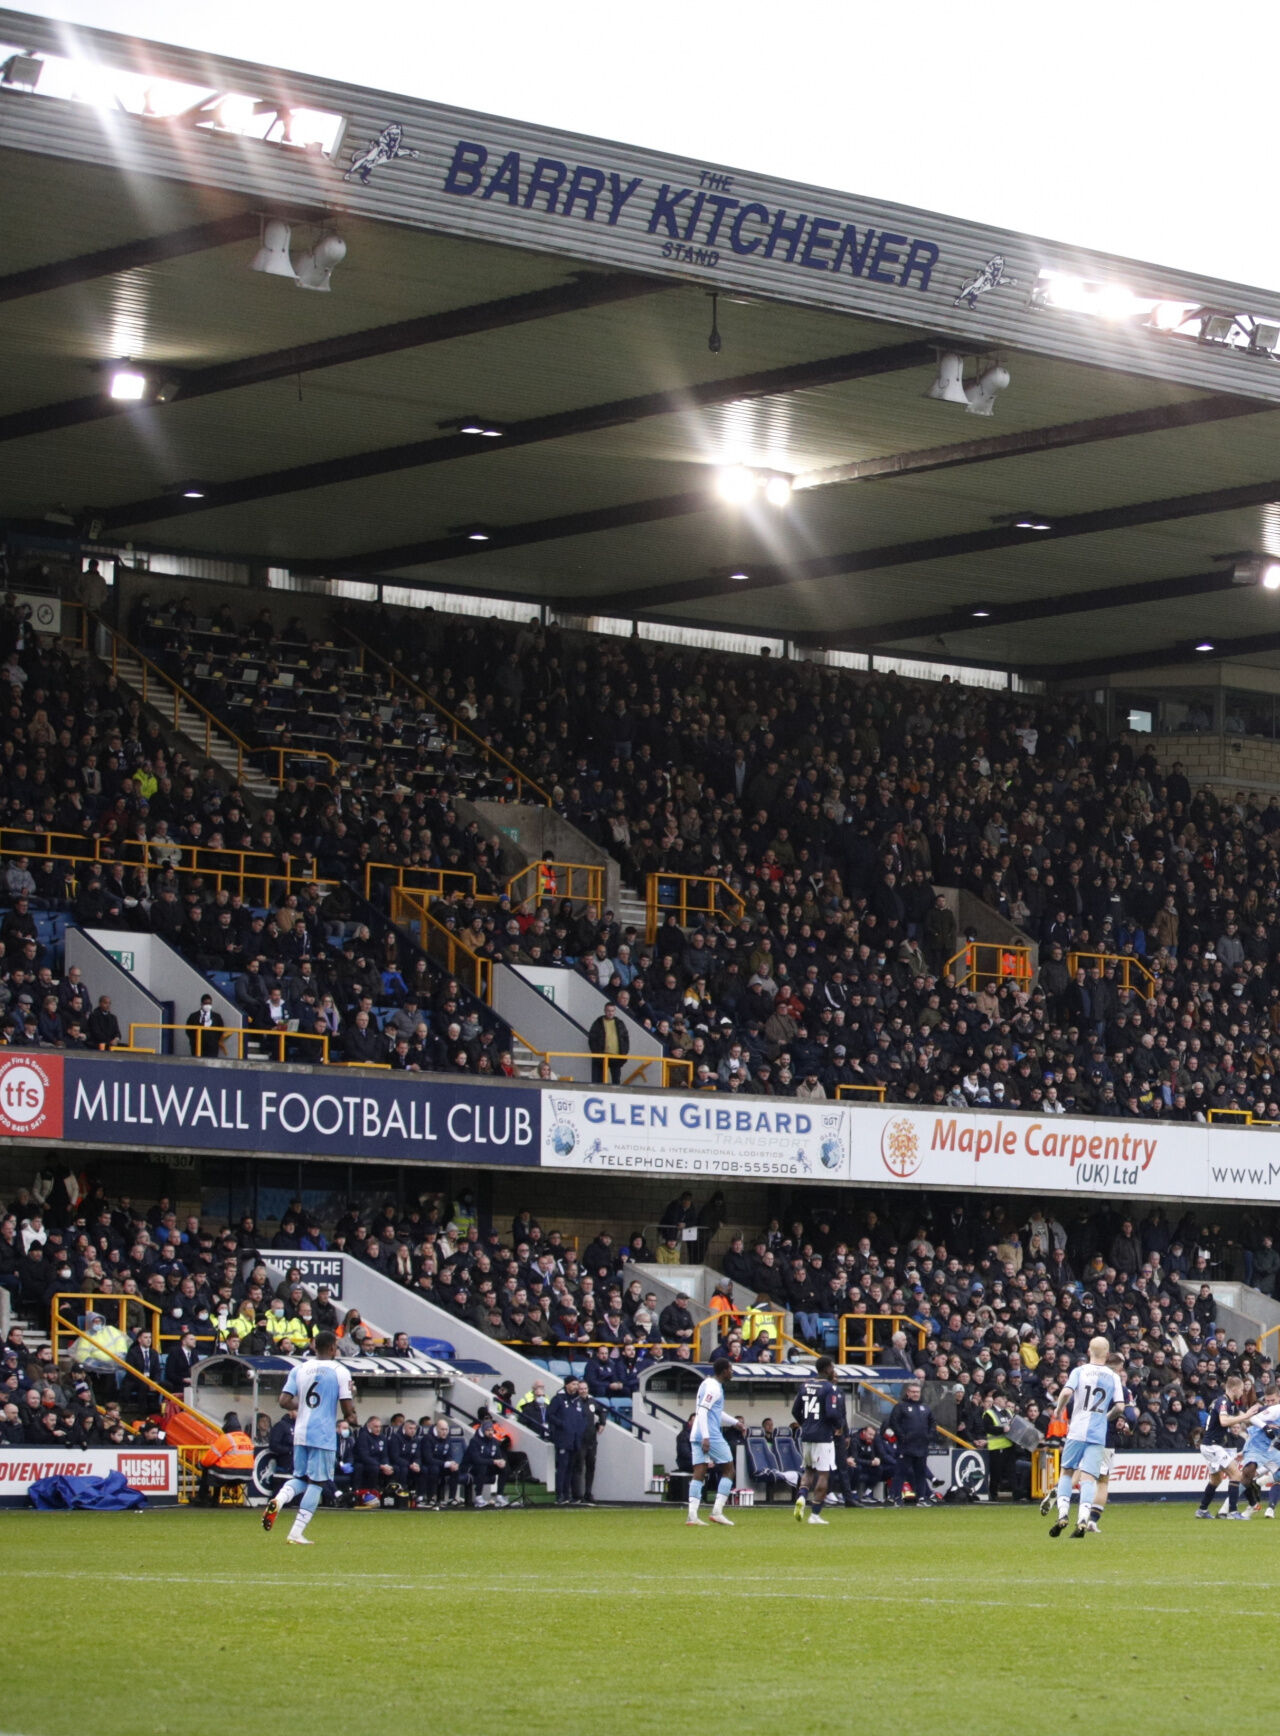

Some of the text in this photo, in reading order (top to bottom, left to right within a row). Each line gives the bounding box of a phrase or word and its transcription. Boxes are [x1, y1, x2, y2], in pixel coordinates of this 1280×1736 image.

[700, 170, 734, 191] THE
[444, 141, 940, 292] BARRY KITCHENER
[661, 241, 720, 268] STAND
[5, 1081, 39, 1108] tfs
[73, 1078, 533, 1146] MILLWALL FOOTBALL CLUB
[584, 1097, 812, 1134] GLEN GIBBARD
[931, 1118, 1157, 1170] Maple Carpentry
[600, 1155, 688, 1169] TELEPHONE:
[1076, 1163, 1138, 1186] (UK) Ltd
[262, 1258, 341, 1275] HIS IS THE
[306, 1381, 321, 1409] 6
[801, 1395, 820, 1420] 14
[1083, 1384, 1106, 1414] 12
[0, 1462, 93, 1481] DVENTURE!
[121, 1459, 165, 1476] HUSKI
[1150, 1465, 1171, 1480] THE
[127, 1477, 165, 1486] HOCOLATE
